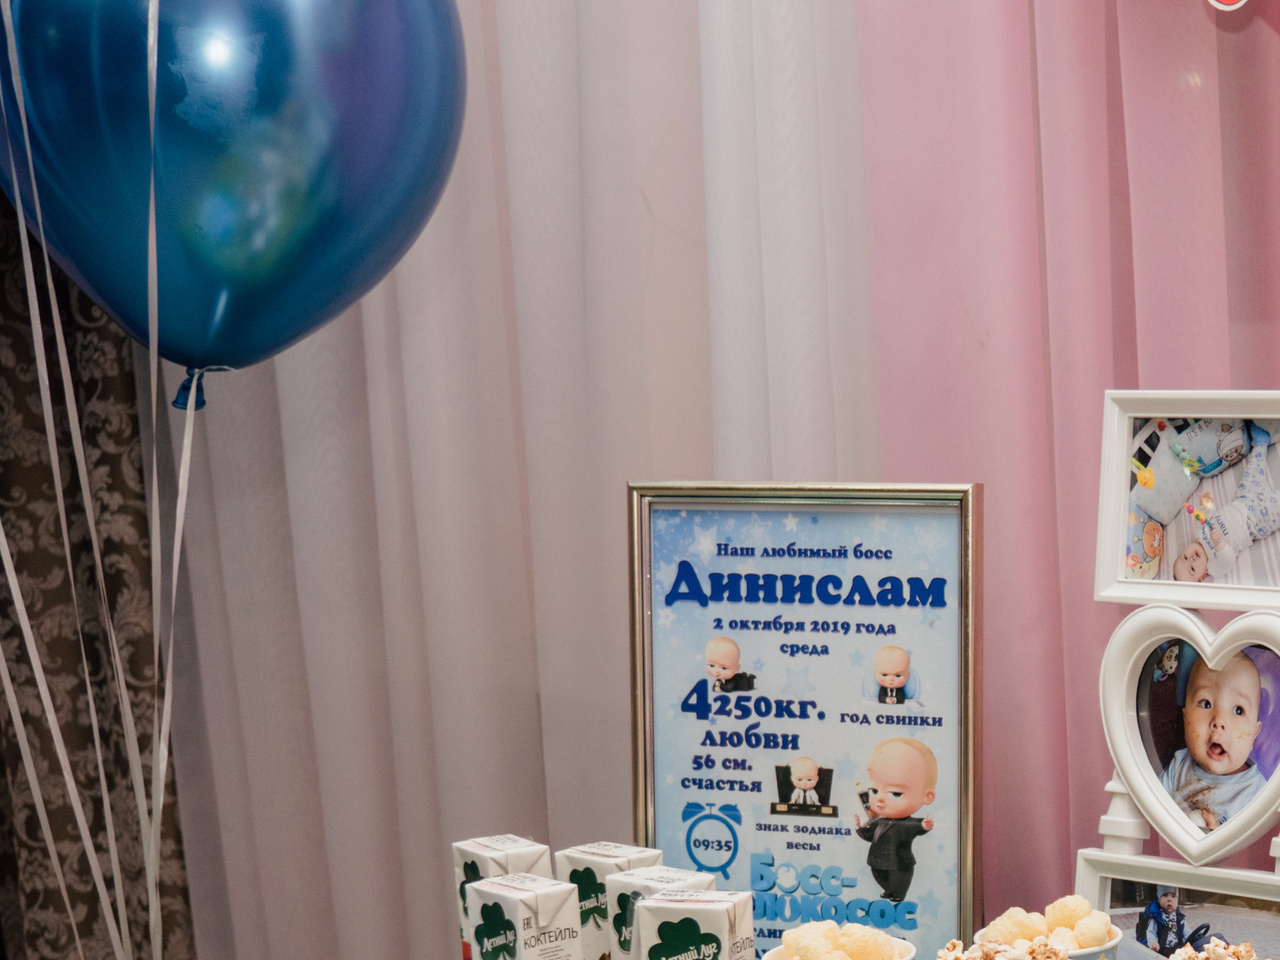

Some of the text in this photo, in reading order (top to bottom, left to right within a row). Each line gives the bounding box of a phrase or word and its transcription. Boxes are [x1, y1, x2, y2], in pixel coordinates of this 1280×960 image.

[716, 542, 893, 560] Наш любимый босс
[664, 560, 948, 608] Динислам
[713, 615, 896, 636] 2 октября 2019 года
[780, 643, 829, 657] среда
[840, 712, 943, 727] год свинки
[700, 722, 800, 750] любви
[692, 755, 753, 771] 56 см.
[681, 777, 762, 792] счастья
[755, 822, 852, 837] знак зодиака
[693, 838, 733, 852] 09:35
[786, 841, 821, 851] весы
[482, 931, 506, 952] Летний
[523, 927, 579, 950] КОКТЕЙЛЬ
